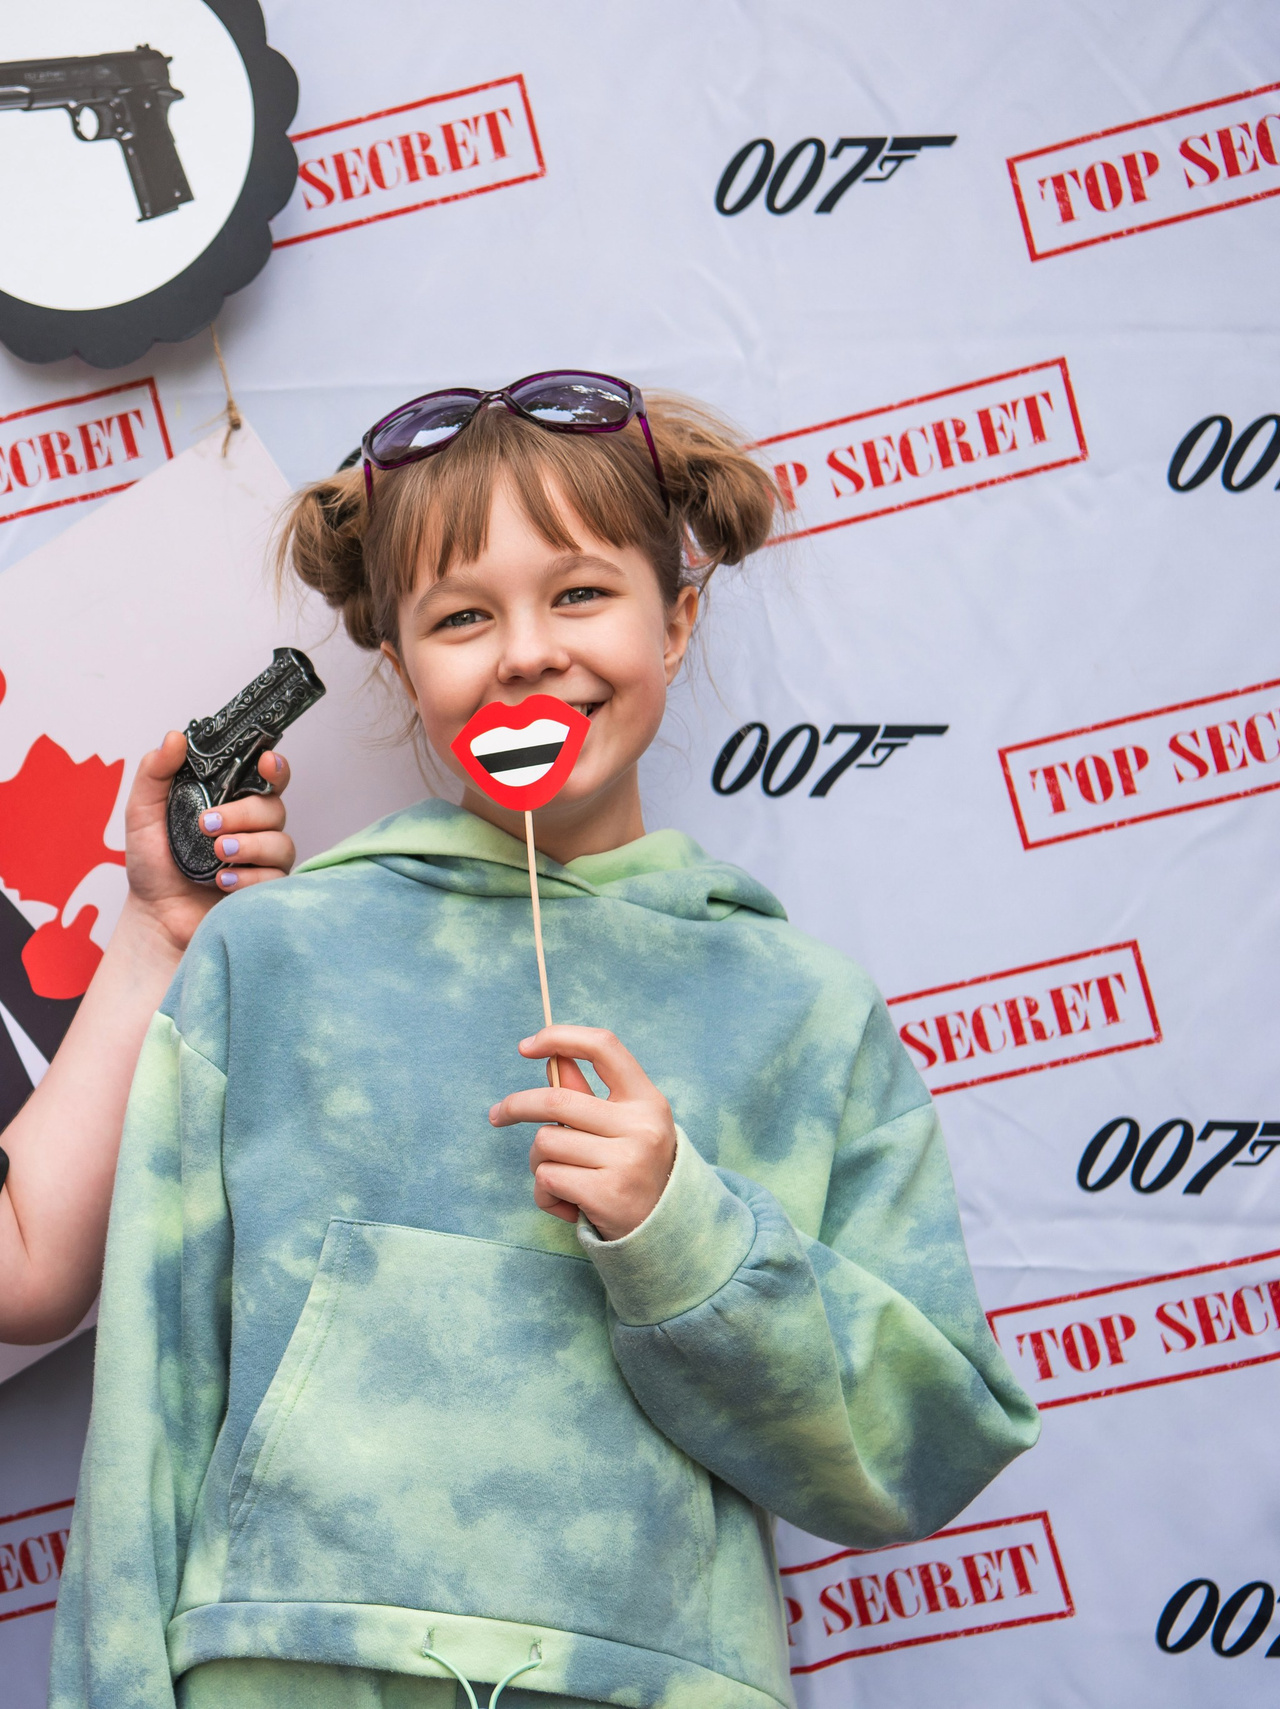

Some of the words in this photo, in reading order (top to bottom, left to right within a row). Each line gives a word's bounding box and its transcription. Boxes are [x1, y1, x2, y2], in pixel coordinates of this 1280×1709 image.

[297, 106, 514, 211] SECRET
[714, 137, 889, 216] 007
[1036, 150, 1161, 226] TOP
[1178, 112, 1280, 190] SEC
[825, 390, 1055, 500] SECRET
[1167, 412, 1280, 494] 00
[711, 721, 879, 798] 007
[1028, 745, 1150, 817] TOP
[1168, 708, 1280, 785] SEC
[898, 971, 1128, 1071] SECRET
[1076, 1116, 1261, 1196] 007
[1015, 1313, 1137, 1383] TOP
[819, 1543, 1039, 1638] SECRET
